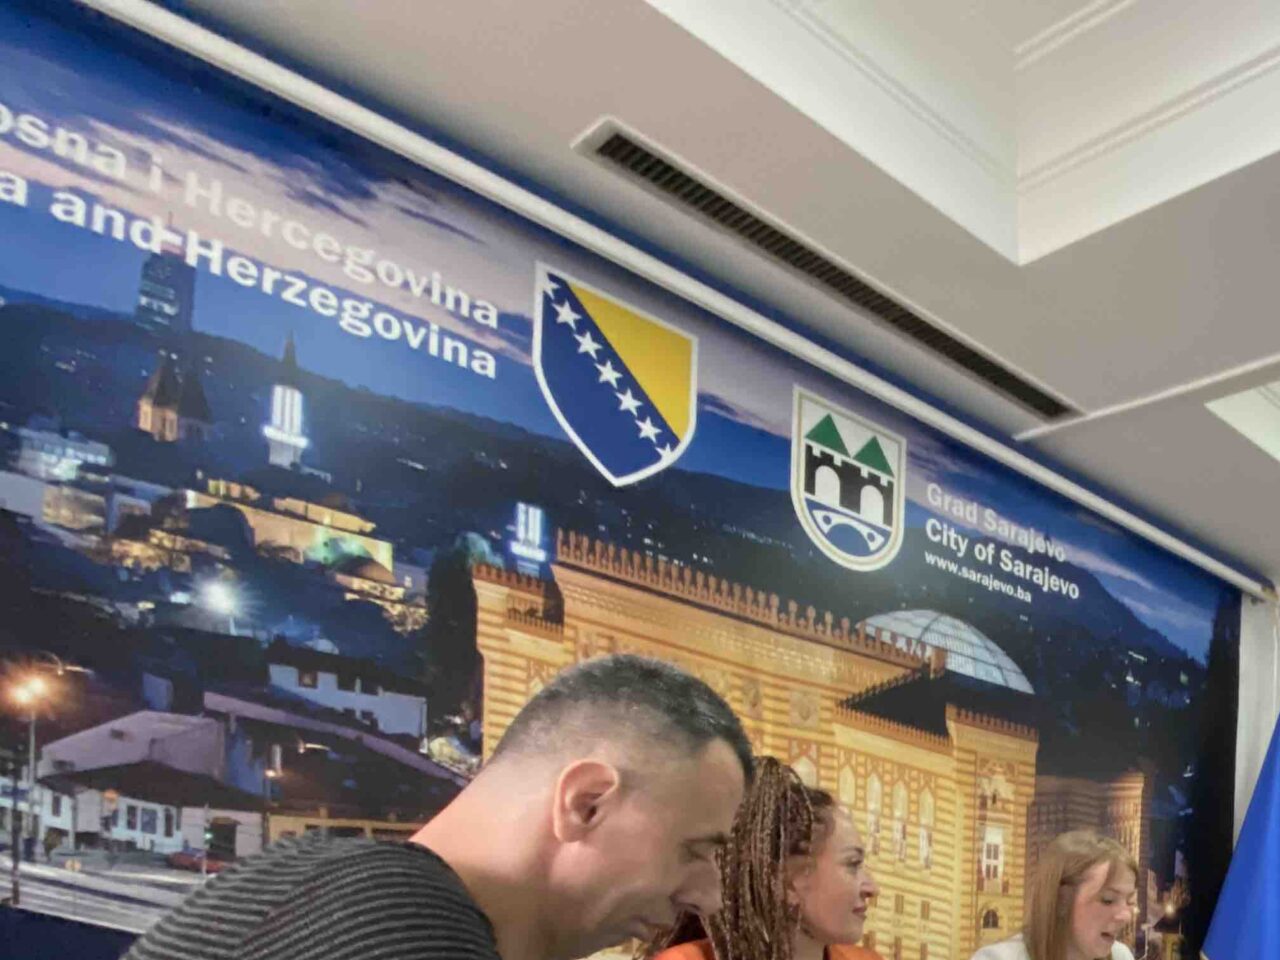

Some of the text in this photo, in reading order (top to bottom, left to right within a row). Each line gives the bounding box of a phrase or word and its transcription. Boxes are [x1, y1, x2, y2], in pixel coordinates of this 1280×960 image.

[150, 153, 162, 193] i
[184, 170, 499, 330] Hercegovina
[50, 190, 163, 255] and
[184, 229, 497, 380] Herzegovina
[925, 518, 1080, 600] City of Sarajevo
[927, 482, 1067, 563] Grad Sarajevo
[924, 551, 1032, 604] www.sarajevo.ba
